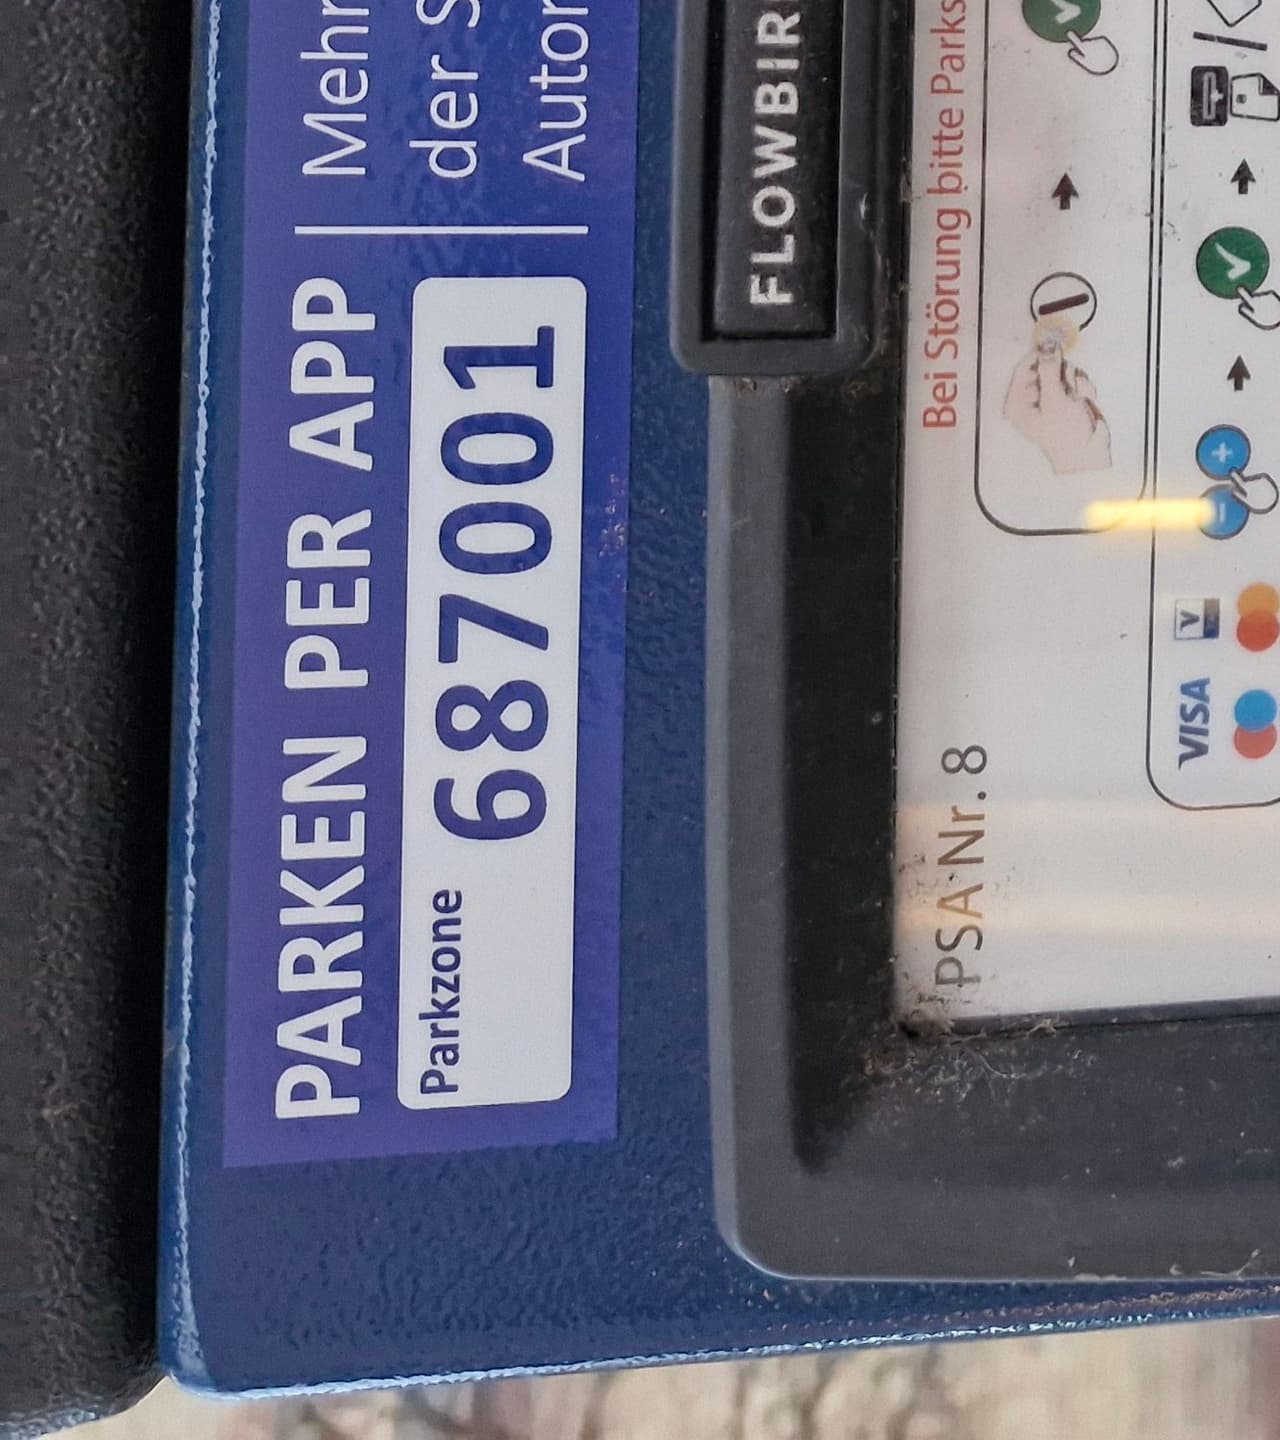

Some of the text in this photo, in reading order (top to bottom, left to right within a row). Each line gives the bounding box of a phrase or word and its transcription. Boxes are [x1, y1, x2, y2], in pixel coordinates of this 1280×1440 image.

[411, 54, 481, 179] der
[927, 109, 965, 195] bitte
[924, 208, 971, 359] Störung
[923, 373, 957, 428] Bei
[433, 326, 555, 841] 687001
[275, 277, 375, 1120] PARKEN PER APP
[1177, 677, 1210, 770] VISA
[934, 744, 987, 985] PSA Nr. 8
[419, 889, 464, 1096] Parkzone
